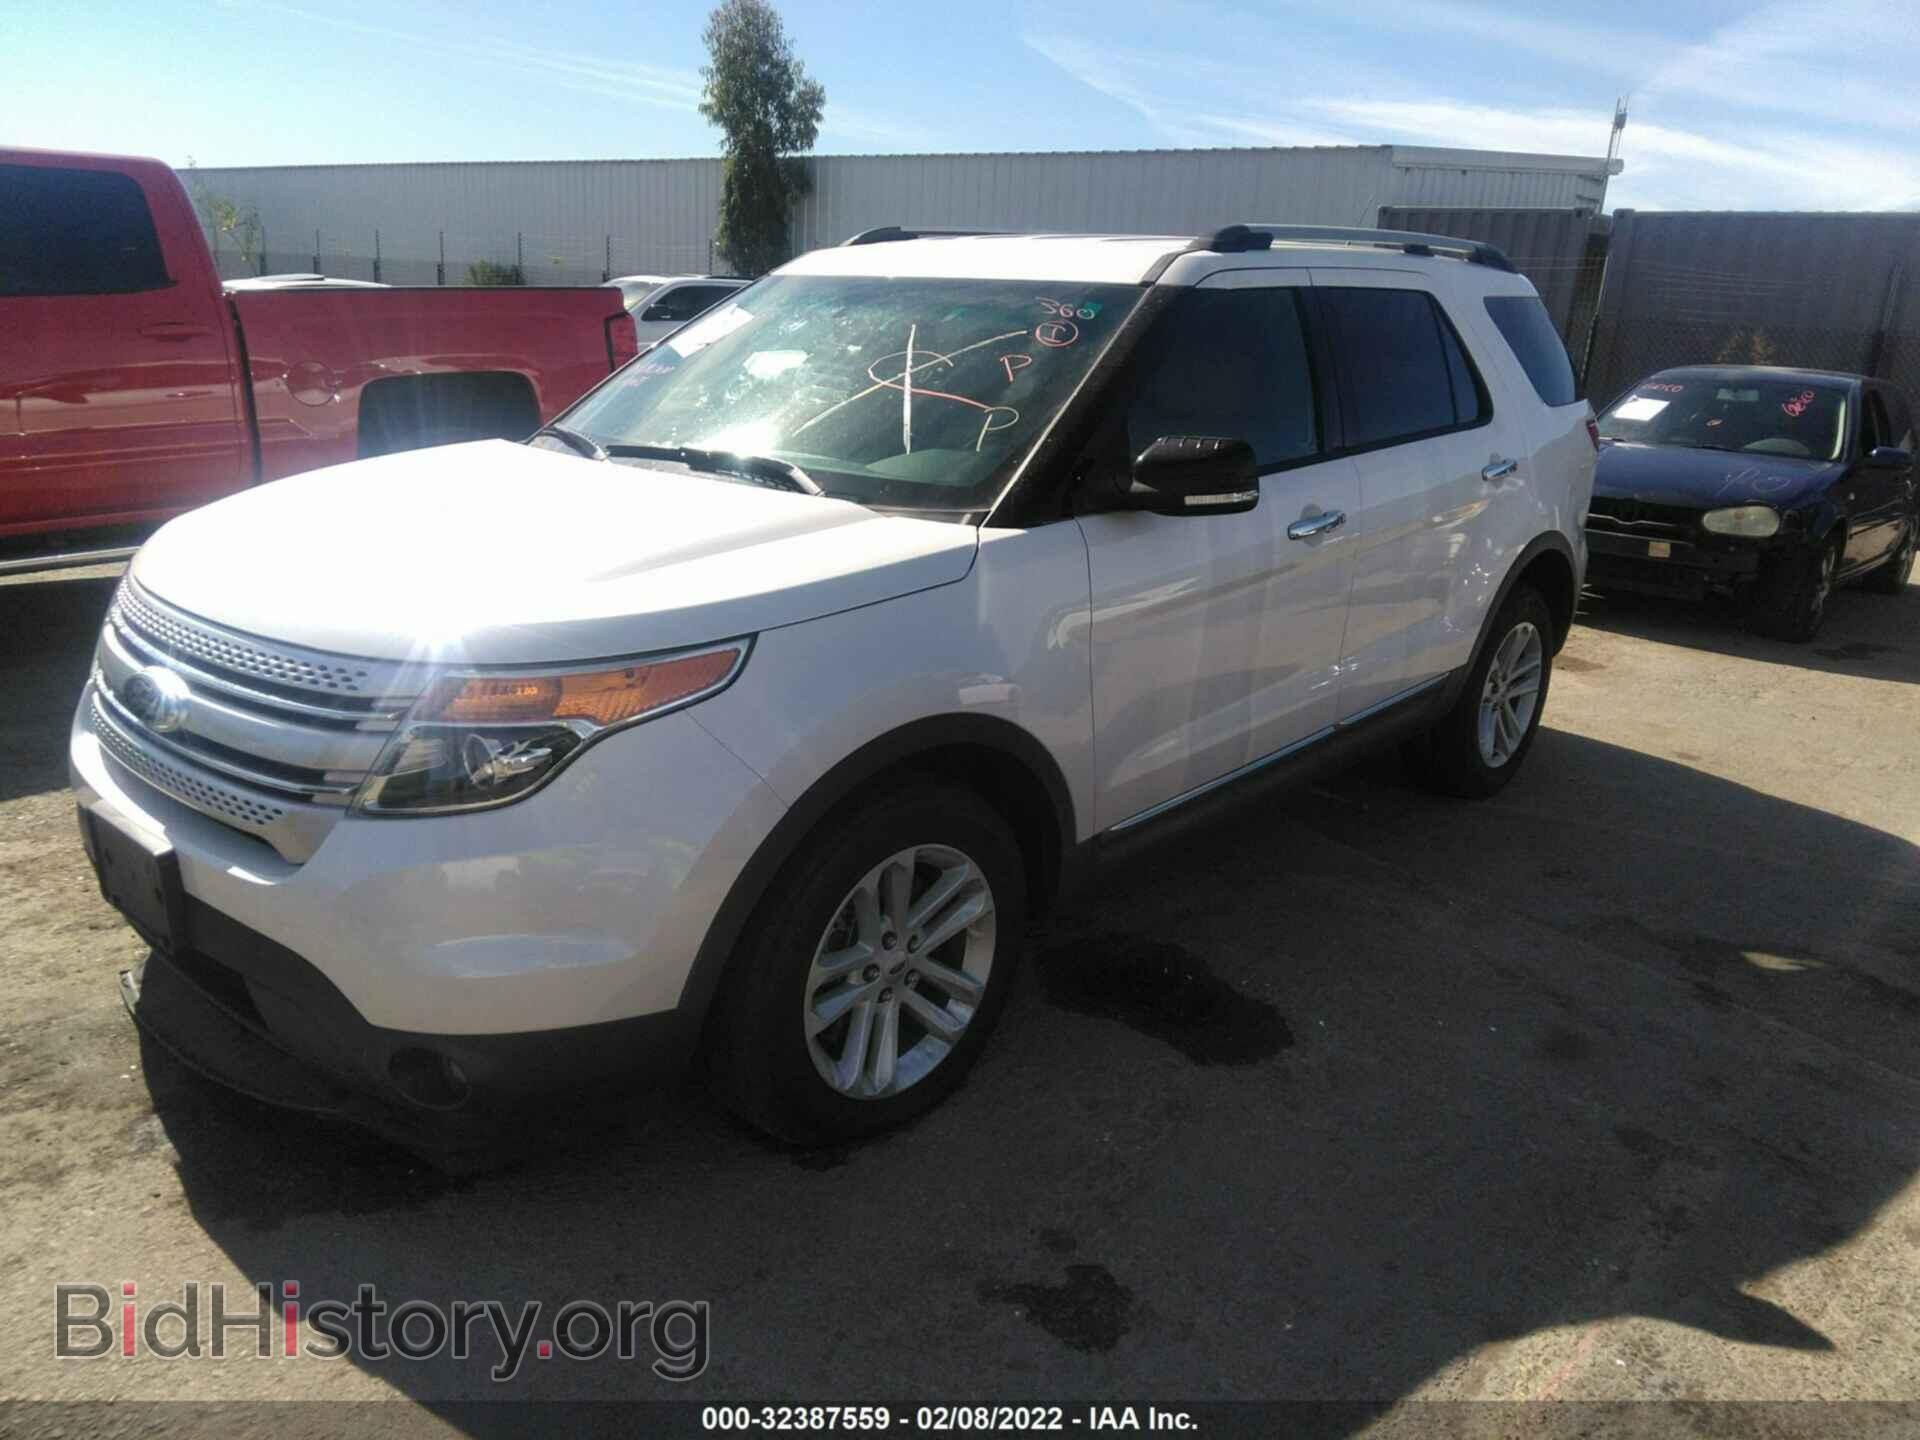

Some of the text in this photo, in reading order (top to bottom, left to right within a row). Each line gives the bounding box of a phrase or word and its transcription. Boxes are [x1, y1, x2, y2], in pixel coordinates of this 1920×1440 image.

[1035, 296, 1095, 320] 360
[1000, 353, 1032, 382] P
[976, 405, 1020, 452] P
